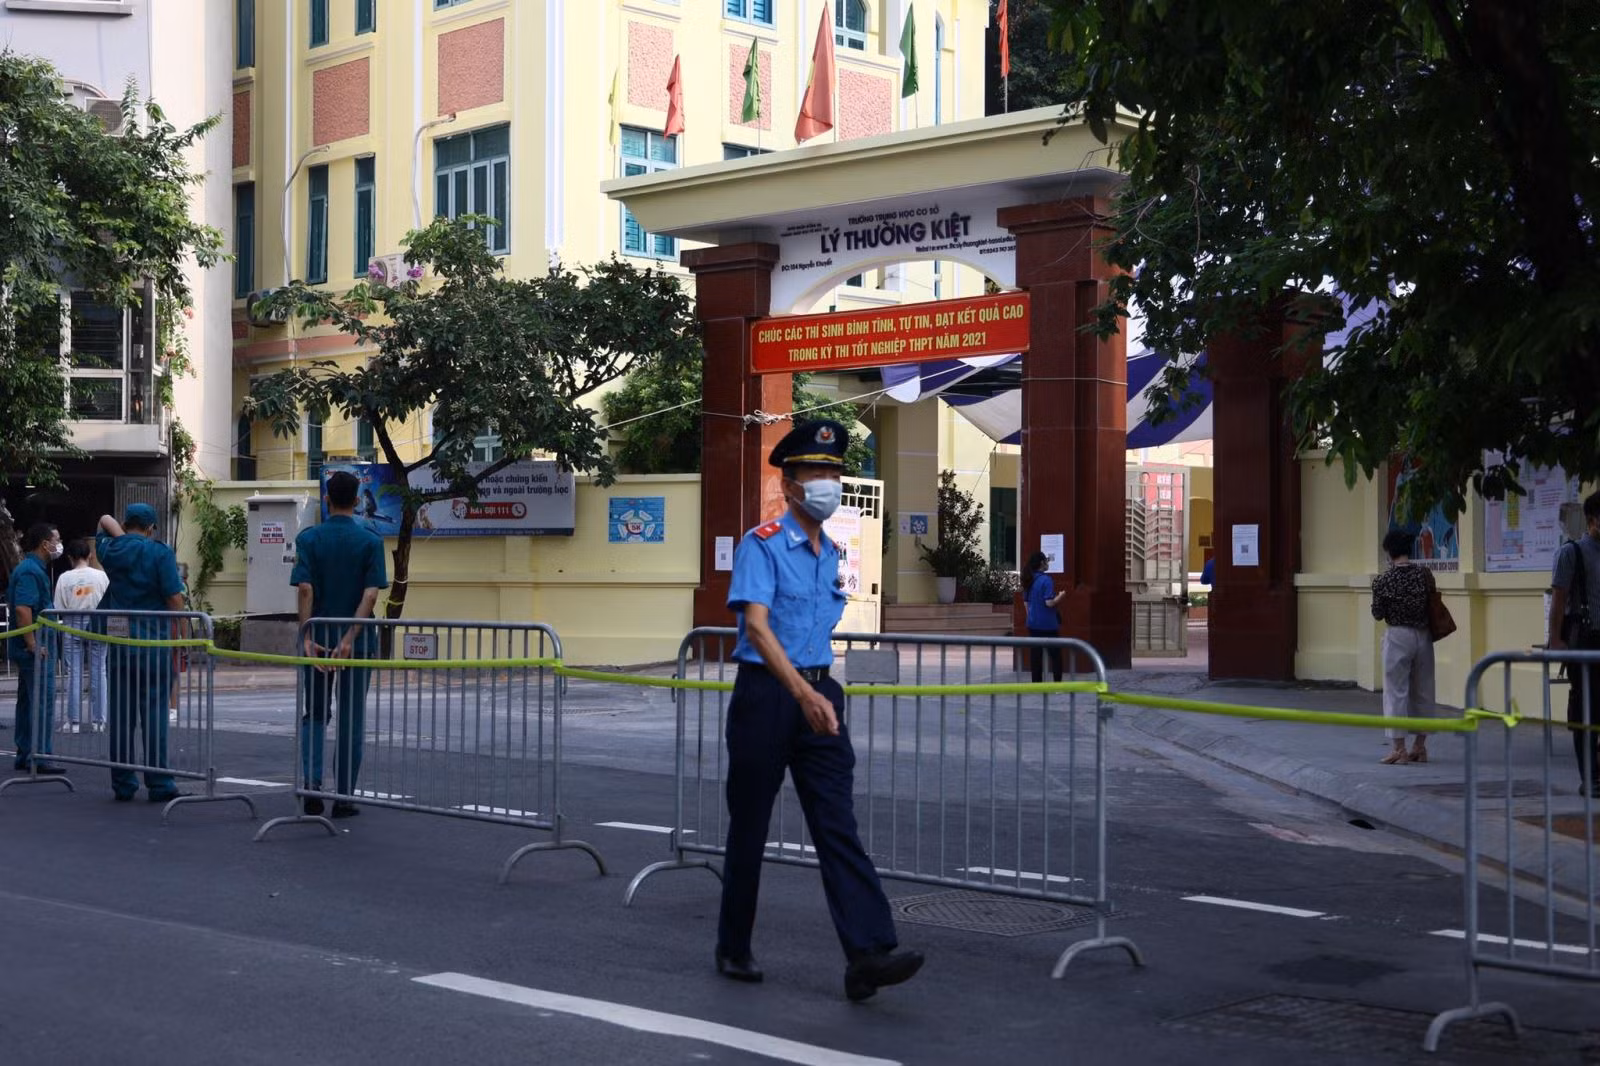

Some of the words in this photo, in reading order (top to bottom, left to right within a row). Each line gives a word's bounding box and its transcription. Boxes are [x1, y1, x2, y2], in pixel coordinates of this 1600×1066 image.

[898, 209, 915, 220] HỌC
[820, 227, 840, 254] LÝ
[844, 221, 927, 251] THƯỜNG
[931, 211, 972, 242] KIỆT
[758, 327, 782, 343] CHÚC
[784, 325, 803, 341] CÁC
[805, 322, 819, 339] THÍ
[821, 323, 844, 338] SINH
[846, 320, 869, 335] BÌNH
[899, 315, 912, 333] TỰ
[914, 315, 933, 330] TIN,
[935, 312, 955, 329] ĐẠT
[957, 306, 976, 324] KẾT
[979, 302, 1000, 324] QUẢ
[1002, 304, 1024, 320] CAO
[788, 347, 818, 362] TRONG
[834, 344, 849, 358] THI
[852, 338, 868, 356] TỐT
[870, 337, 906, 356] NGHIỆP
[909, 337, 933, 352] THPT
[936, 332, 960, 349] NĂM
[962, 331, 987, 347] 2021
[409, 644, 429, 656] STOP
